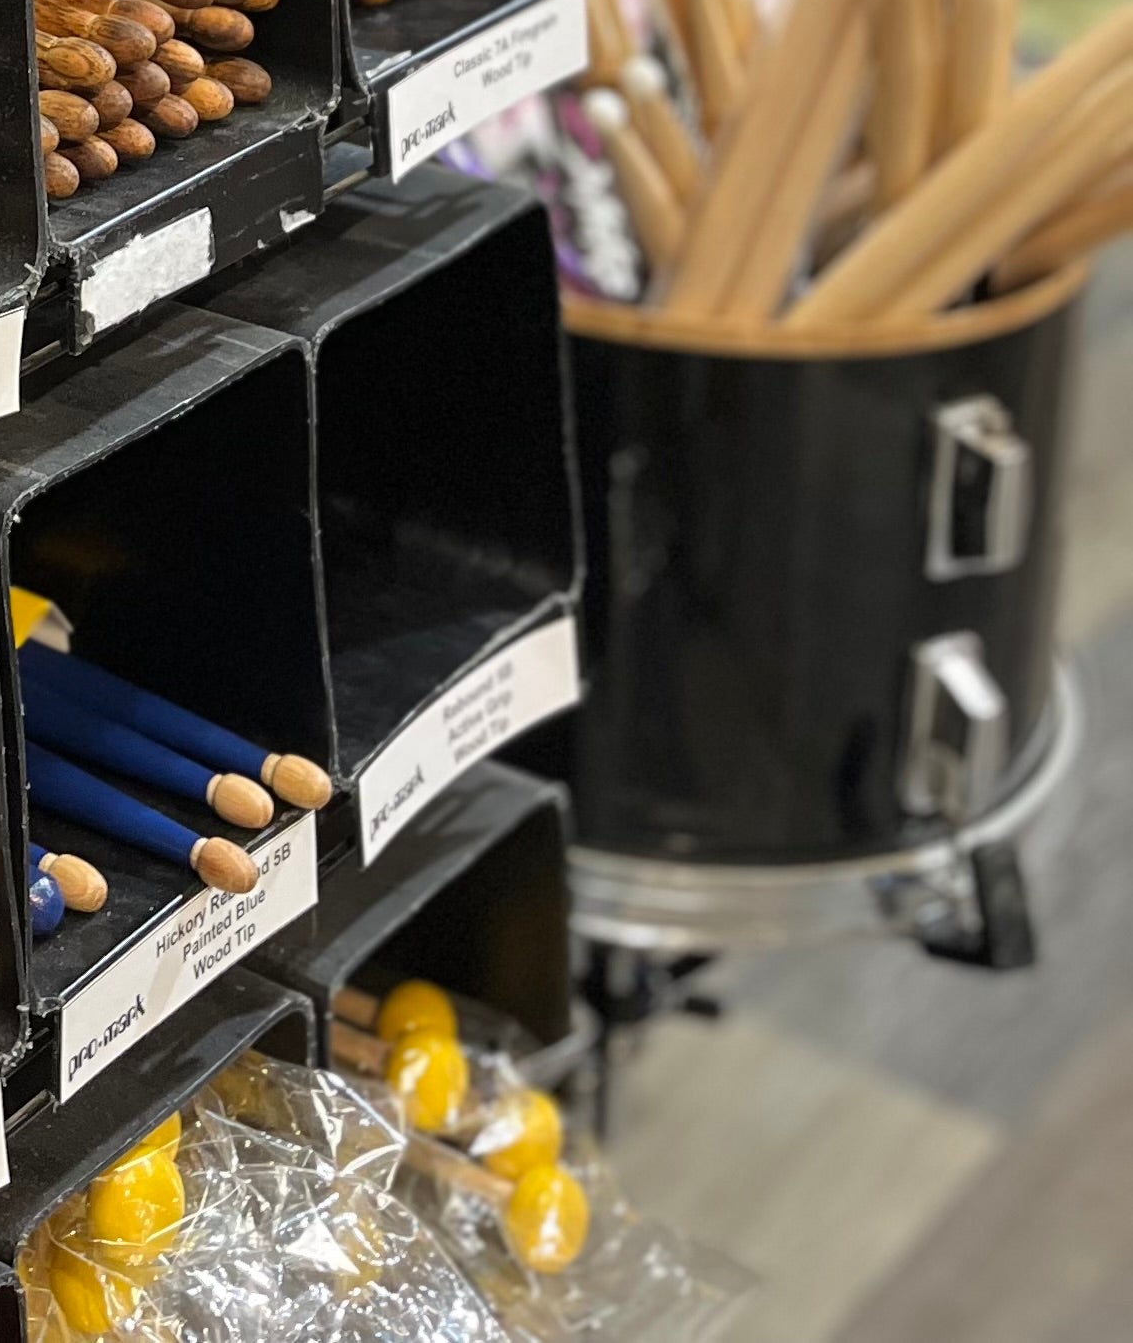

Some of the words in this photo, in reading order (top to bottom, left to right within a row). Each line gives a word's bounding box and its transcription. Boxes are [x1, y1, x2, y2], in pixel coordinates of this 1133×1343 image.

[453, 47, 492, 79] Classic
[481, 64, 513, 88] Wood
[155, 906, 206, 958] Hickory
[273, 842, 292, 867] 5B
[182, 914, 232, 963] Painted
[235, 888, 267, 922] Blue
[192, 938, 232, 981] Wood
[235, 922, 257, 947] Tip
